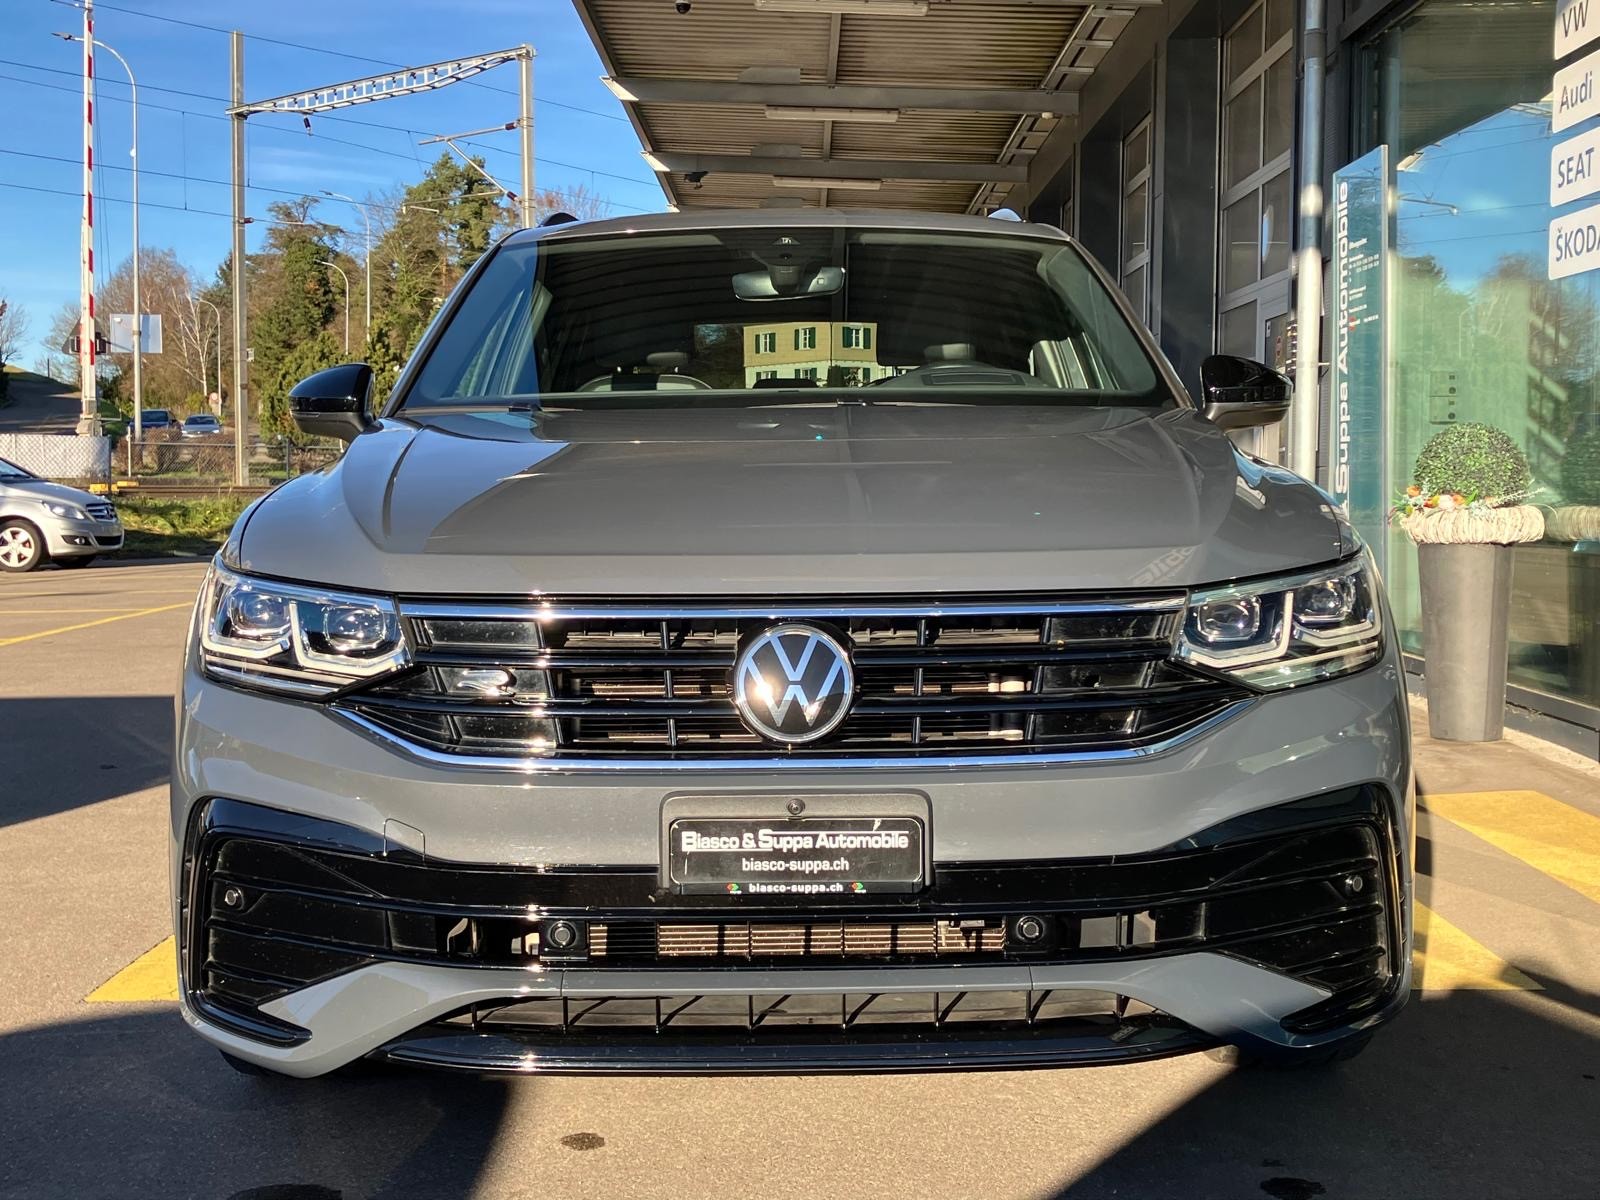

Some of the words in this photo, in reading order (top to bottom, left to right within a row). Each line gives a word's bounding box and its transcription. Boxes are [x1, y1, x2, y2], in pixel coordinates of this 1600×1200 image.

[1562, 0, 1589, 38] VW
[1559, 71, 1593, 113] Audi
[1557, 147, 1595, 188] SEAT
[1337, 181, 1349, 375] Automobile
[1335, 381, 1351, 494] Suppa
[681, 831, 741, 852] Biasco
[742, 832, 757, 849] &
[758, 829, 813, 853] Suppa
[815, 831, 909, 849] Automobile
[741, 857, 850, 874] biasco-suppa.ch
[748, 883, 844, 894] biasco-suppa.ch
